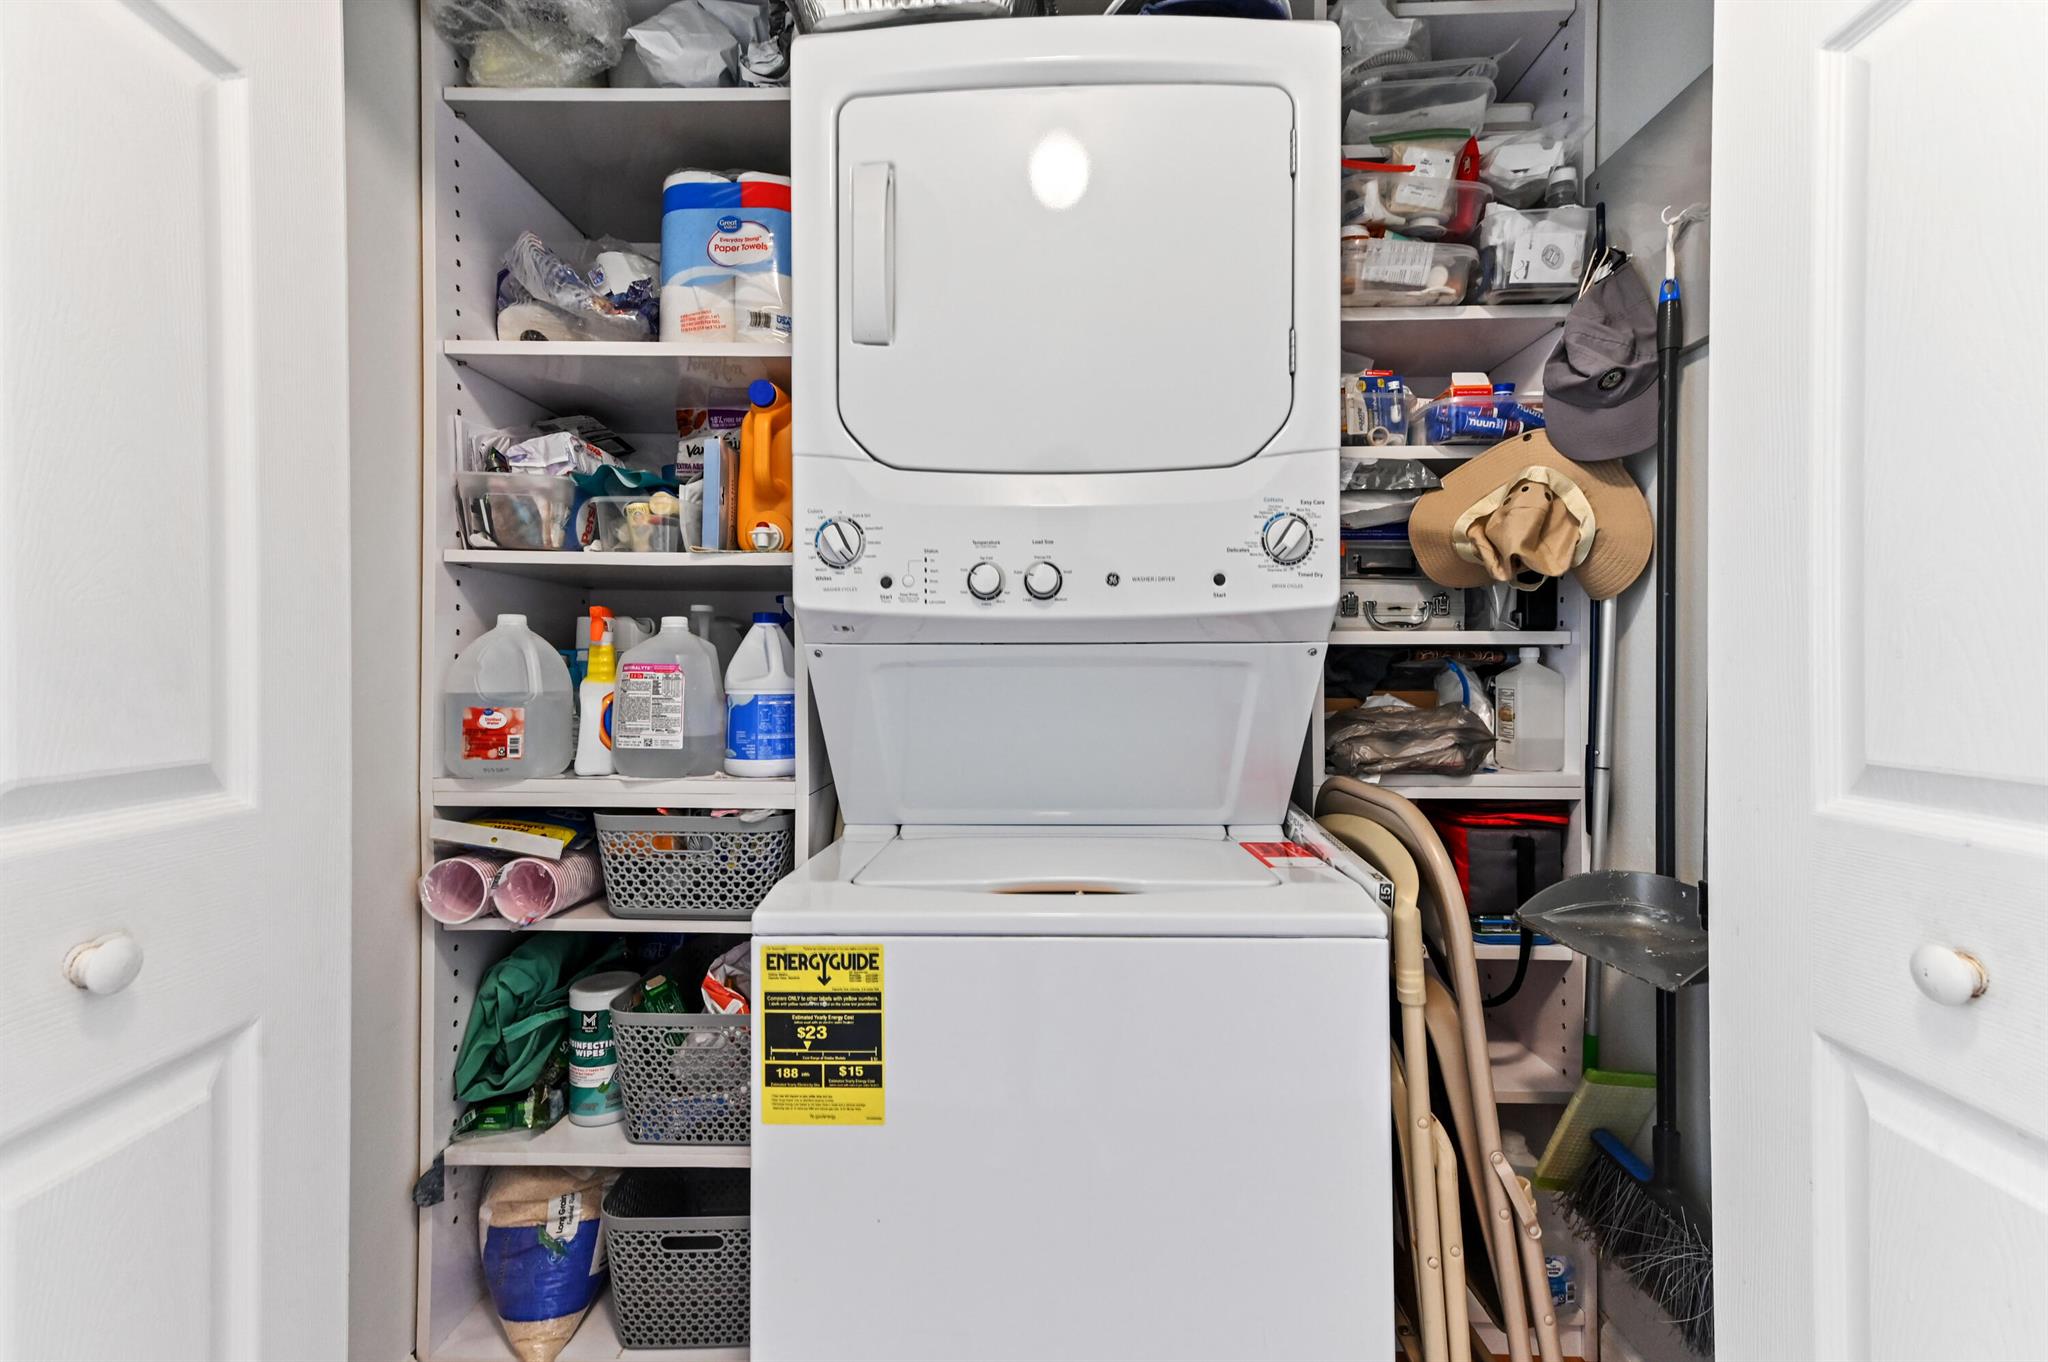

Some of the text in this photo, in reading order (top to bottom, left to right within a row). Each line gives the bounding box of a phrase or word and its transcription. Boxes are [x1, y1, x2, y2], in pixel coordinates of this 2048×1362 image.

[714, 242, 768, 253] Paper Towels
[1469, 418, 1496, 428] nuun
[766, 953, 880, 971] ENERGYGUIDE
[797, 1025, 828, 1039] $23
[575, 1049, 605, 1057] WIPES
[776, 1068, 798, 1078] 188
[839, 1066, 864, 1077] $15
[556, 1194, 567, 1234] Long Grain
